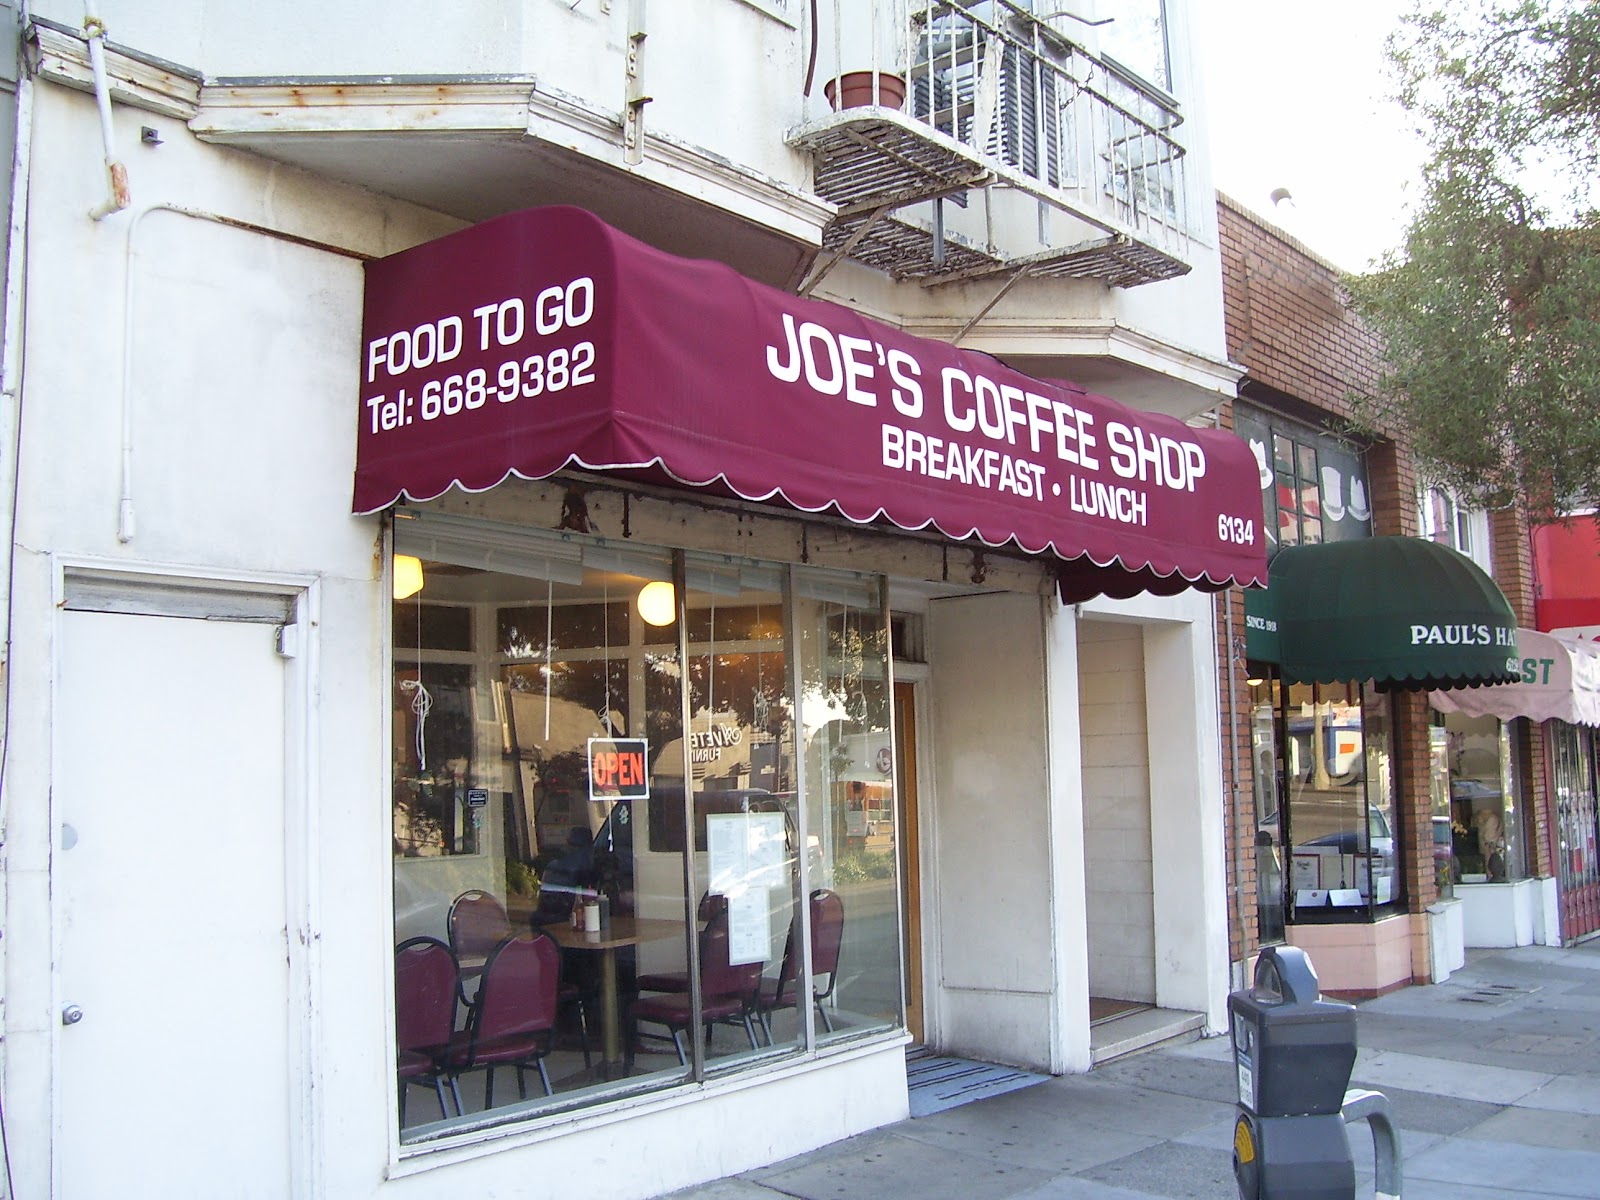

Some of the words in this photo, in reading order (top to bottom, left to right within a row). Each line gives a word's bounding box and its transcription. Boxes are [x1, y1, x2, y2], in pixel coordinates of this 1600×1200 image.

[367, 315, 463, 383] FOOD
[473, 297, 524, 351] TO
[535, 276, 595, 336] GO
[366, 388, 414, 434] Tel:
[421, 341, 596, 421] 668-9382
[766, 313, 923, 419] JOE'S
[942, 367, 1099, 471] COFFEE
[1106, 421, 1206, 493] SHOP
[881, 424, 1046, 502] BREAKFAST
[1069, 479, 1148, 526] LUNCH
[1217, 513, 1255, 547] 6134
[1246, 615, 1265, 630] SINCE
[1410, 624, 1491, 645] PAUL'S
[593, 752, 643, 786] OPEN
